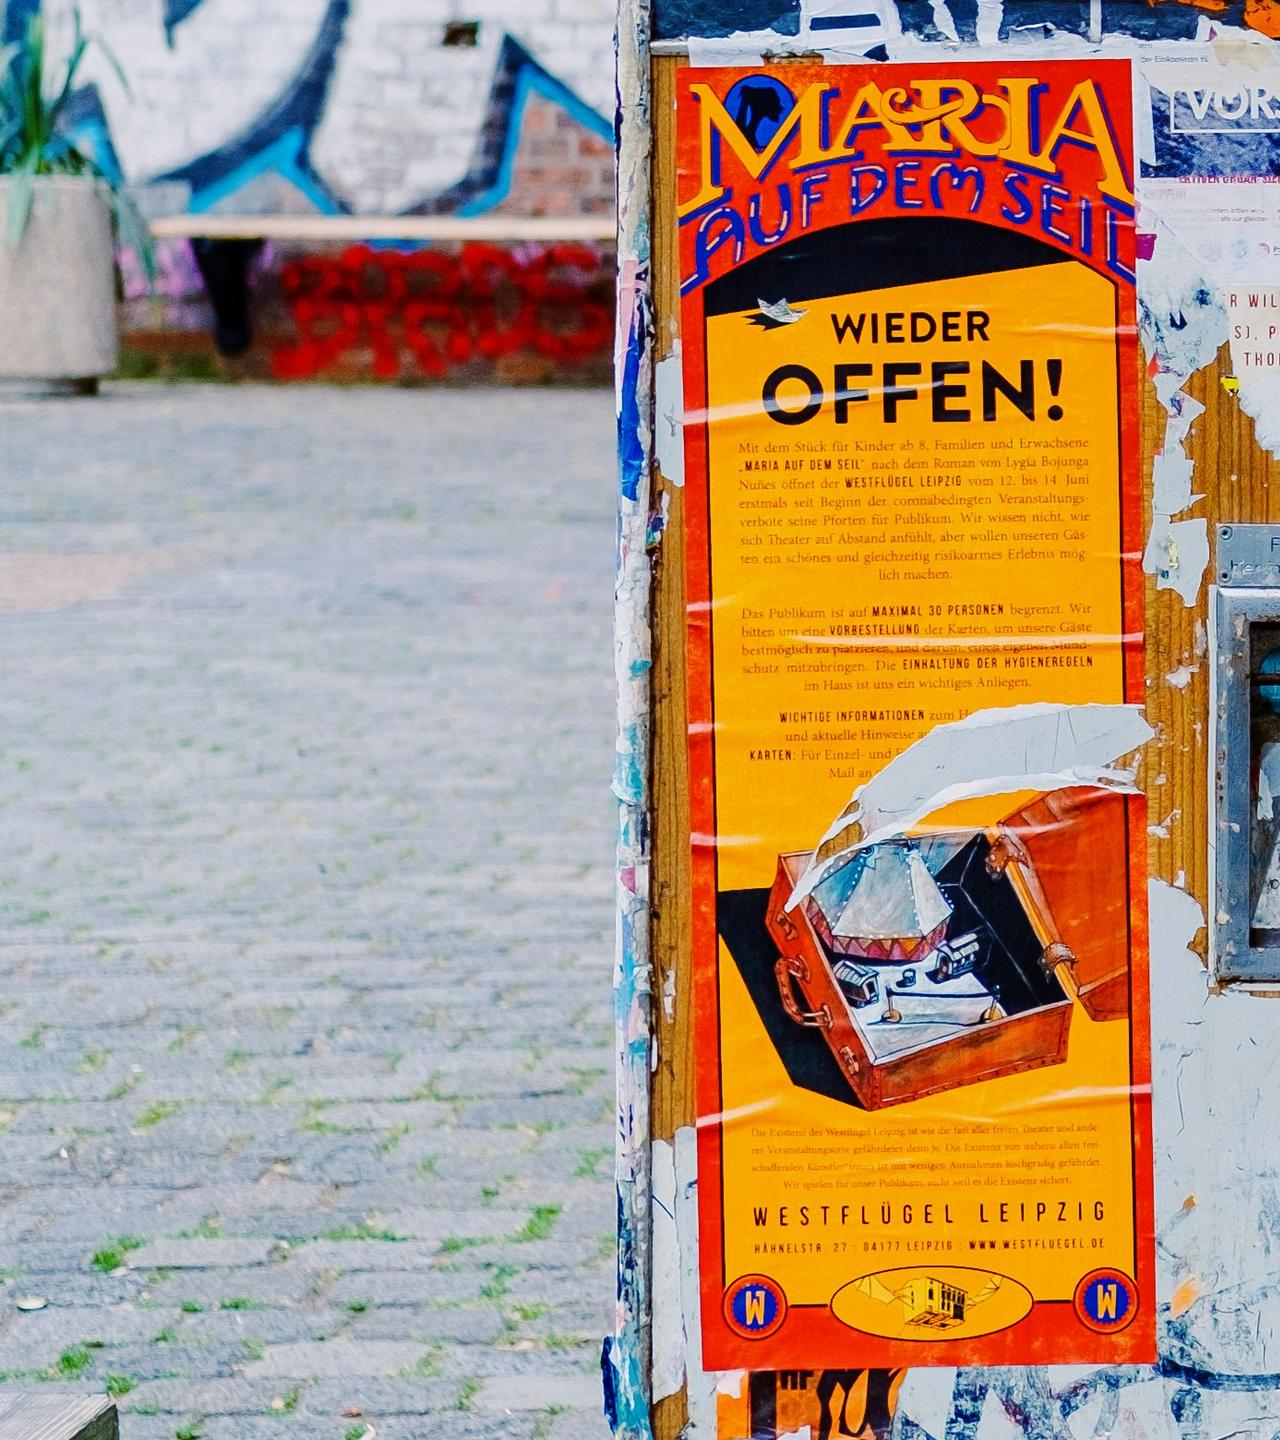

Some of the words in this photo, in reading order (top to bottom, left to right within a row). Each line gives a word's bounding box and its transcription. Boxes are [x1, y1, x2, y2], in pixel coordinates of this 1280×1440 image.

[678, 77, 1134, 217] MARIA
[680, 174, 828, 297] AUF
[850, 161, 986, 215] DEM
[1000, 171, 1136, 286] SEIL
[831, 311, 990, 344] WIEDER
[762, 358, 1064, 425] OFFEN!
[738, 442, 760, 453] Mit
[764, 442, 790, 453] dem
[795, 441, 826, 452] Stück
[833, 441, 850, 452] für
[854, 441, 895, 451] Kinder
[934, 440, 985, 450] Familien
[990, 439, 1014, 450] und
[1019, 439, 1088, 449] Erwachsene
[1005, 457, 1036, 471] Lygia
[1041, 456, 1089, 470] Bojunga
[872, 606, 922, 617] MAXIMAL
[948, 605, 1004, 615] PERSONEN
[829, 625, 920, 636] VORBESTELLUNG
[903, 659, 970, 670] EINHALTUNG
[977, 658, 998, 669] DER
[1004, 656, 1093, 668] HYGIENEREGELN
[779, 711, 831, 722] WICHTIGE
[836, 710, 925, 721] INFORMATIONEN
[753, 1202, 954, 1227] WESTFLÜGEL
[980, 1201, 1104, 1224] LEIPZIG
[834, 1242, 847, 1253] 27
[863, 1241, 901, 1252] 04177
[906, 1240, 953, 1251] LEIPZIG
[969, 1238, 1105, 1250] WWW.WESTFLUEGEL.DE
